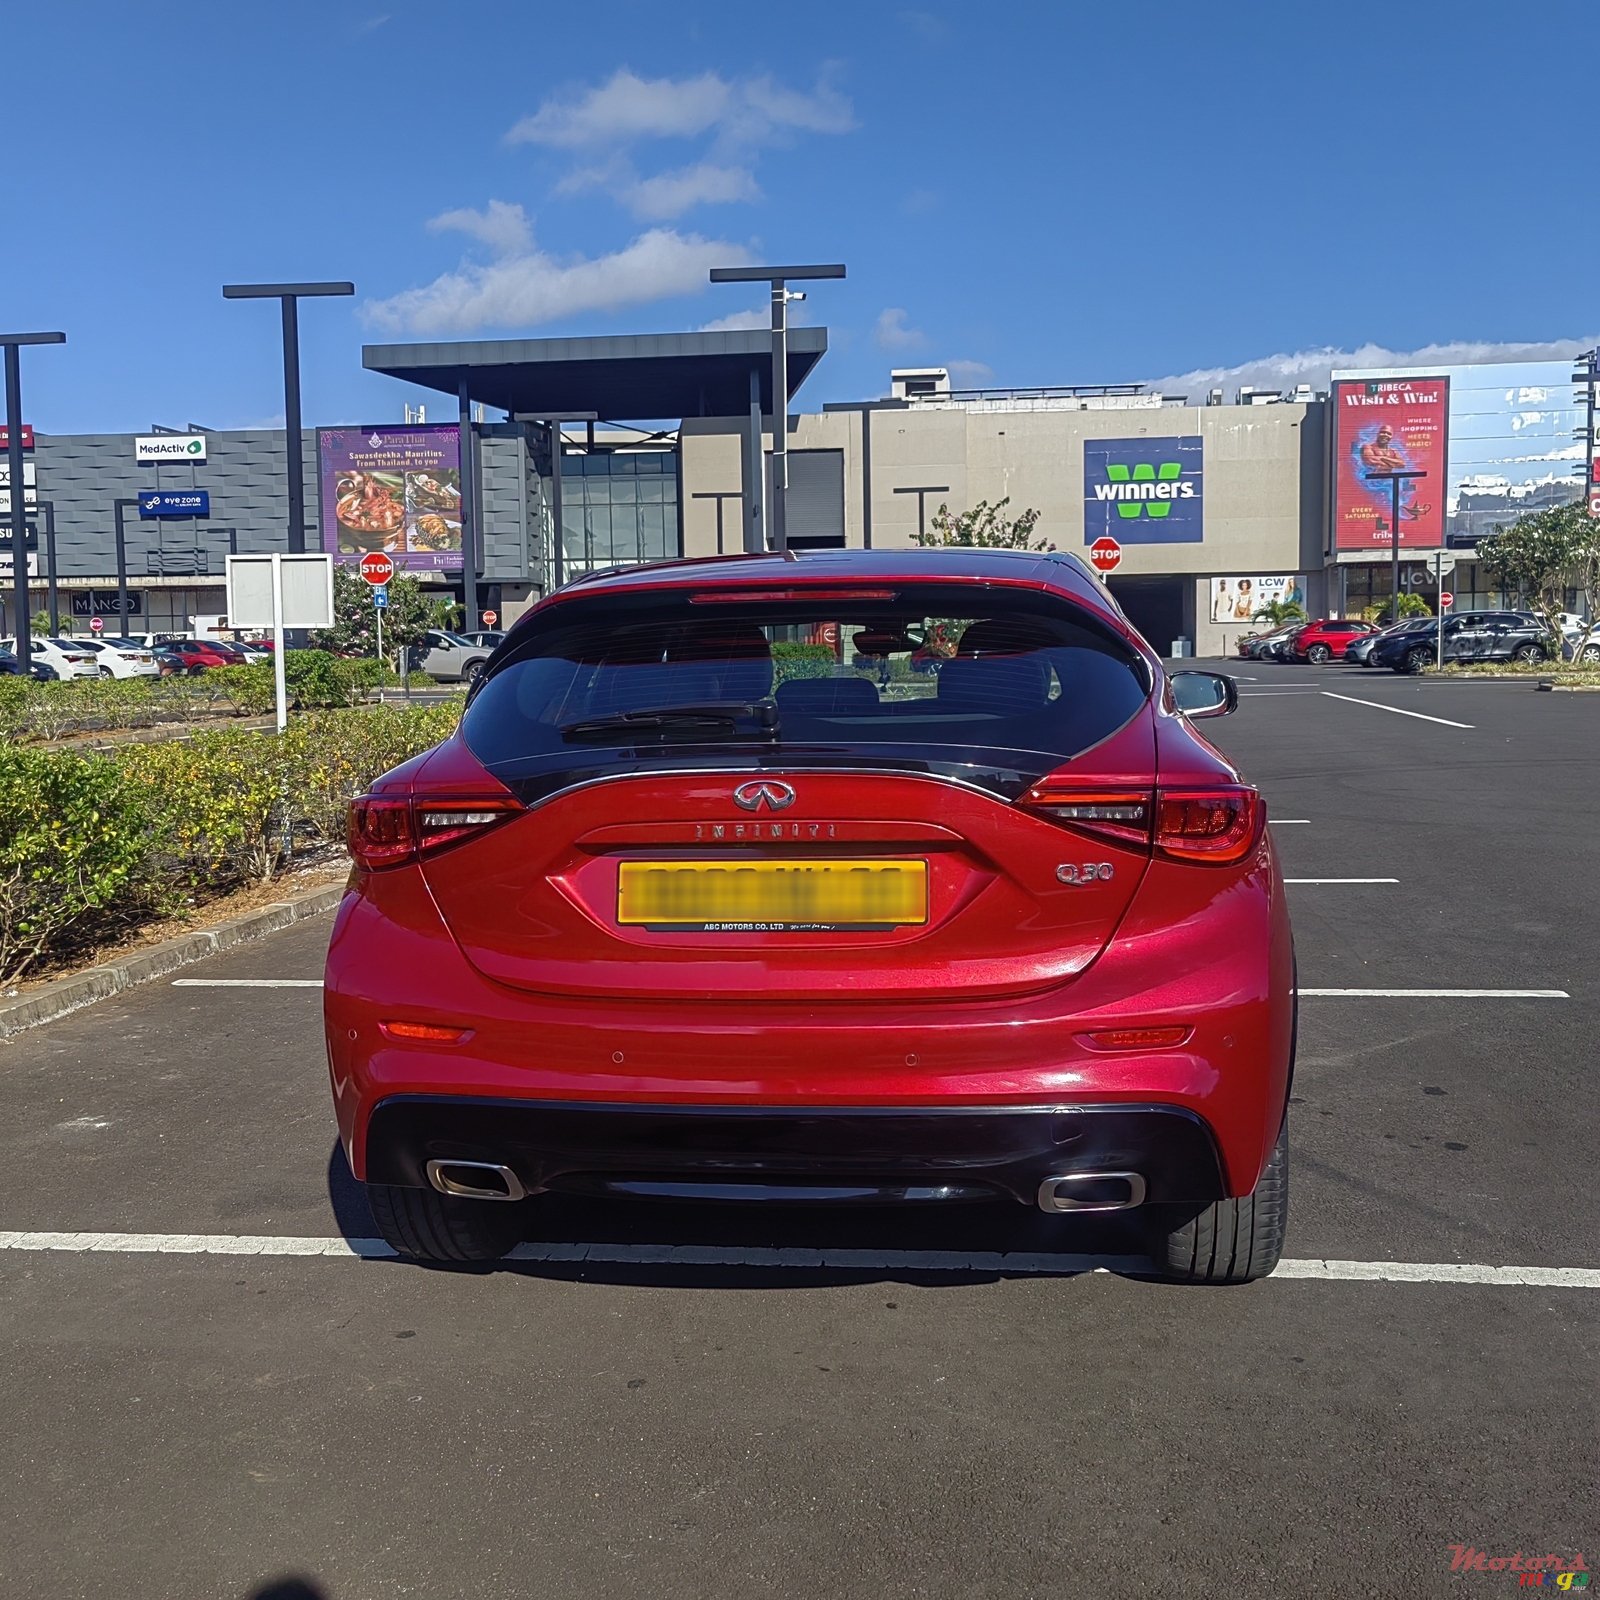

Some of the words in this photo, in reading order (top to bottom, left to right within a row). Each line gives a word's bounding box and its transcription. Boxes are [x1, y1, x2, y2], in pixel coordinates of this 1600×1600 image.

[1371, 383, 1412, 392] TRIBECA
[1346, 394, 1384, 406] Wish
[1386, 393, 1399, 405] &
[1403, 392, 1438, 404] Win!
[140, 444, 185, 453] MedActiv
[1094, 481, 1194, 500] winners
[1091, 549, 1120, 560] STOP
[362, 564, 392, 573] STOP
[1259, 578, 1285, 587] LCW
[695, 823, 835, 838] INFINITI
[1056, 862, 1114, 887] Q30
